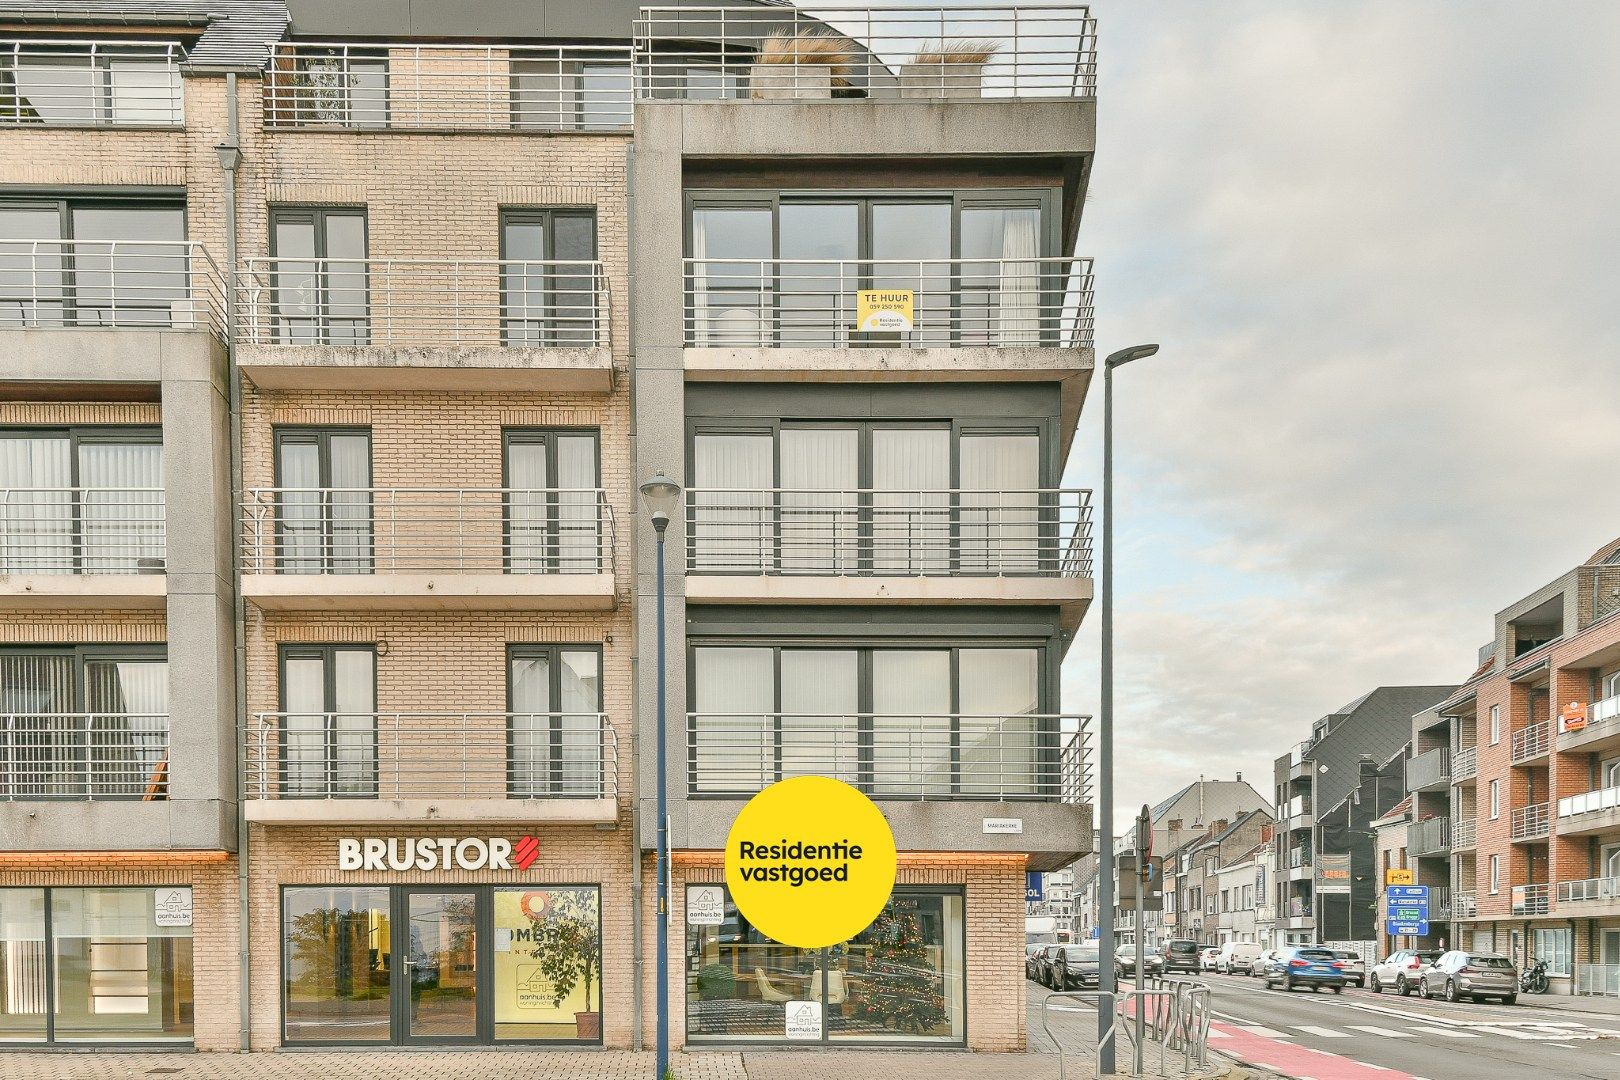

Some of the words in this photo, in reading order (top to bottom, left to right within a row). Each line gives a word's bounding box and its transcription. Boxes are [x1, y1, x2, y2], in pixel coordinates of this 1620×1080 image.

[865, 294, 877, 302] TE
[880, 294, 909, 302] HUUR
[339, 837, 513, 871] BRUSTOR
